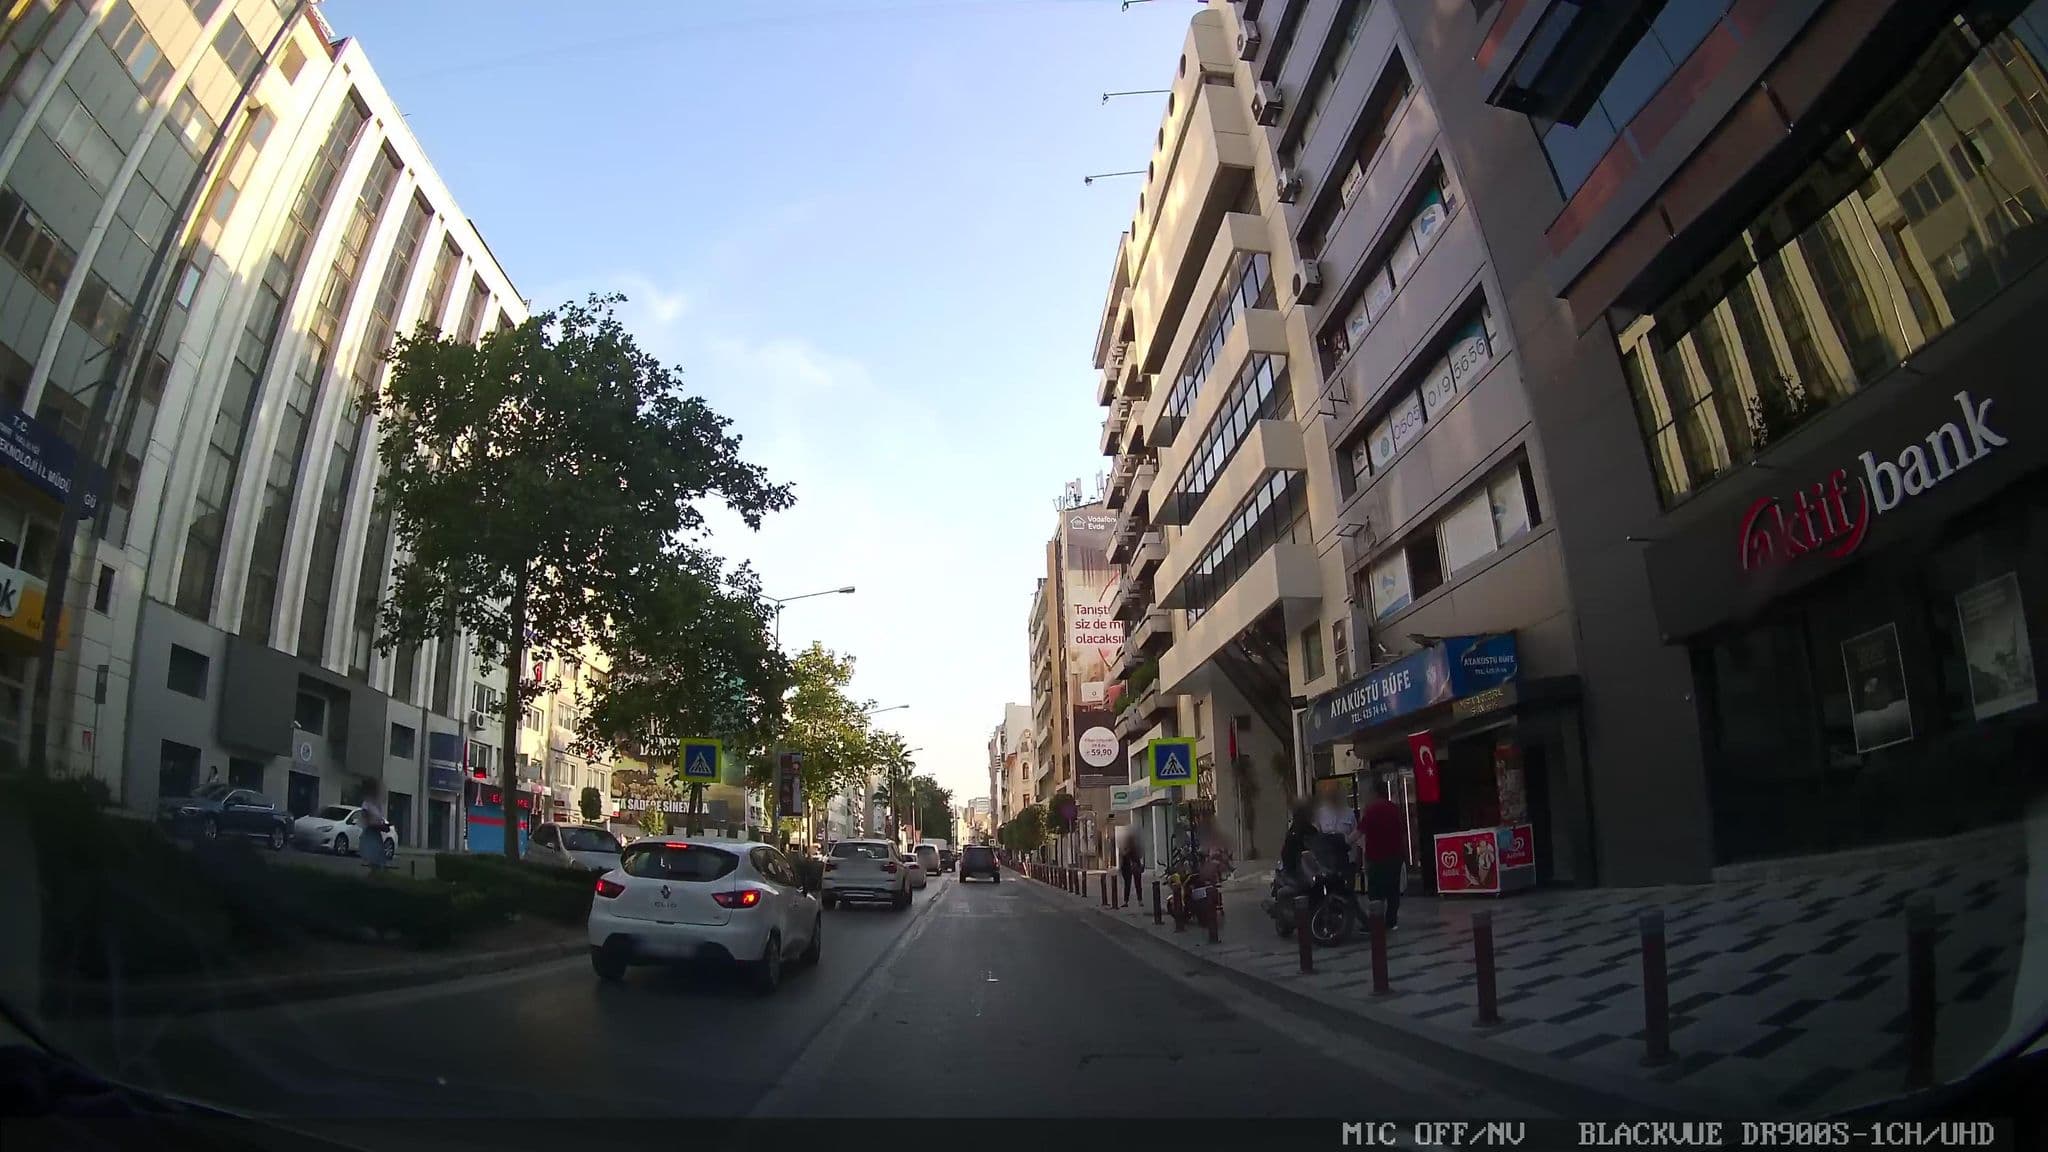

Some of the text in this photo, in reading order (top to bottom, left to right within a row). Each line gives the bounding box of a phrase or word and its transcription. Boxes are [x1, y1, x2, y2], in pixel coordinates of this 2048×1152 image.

[1741, 390, 2009, 568] aktif bank
[1073, 604, 1110, 617] Tanışt
[1075, 619, 1091, 629] siz
[1093, 619, 1107, 629] de
[1331, 670, 1411, 718] AYAKÜSTÜ BÜFE
